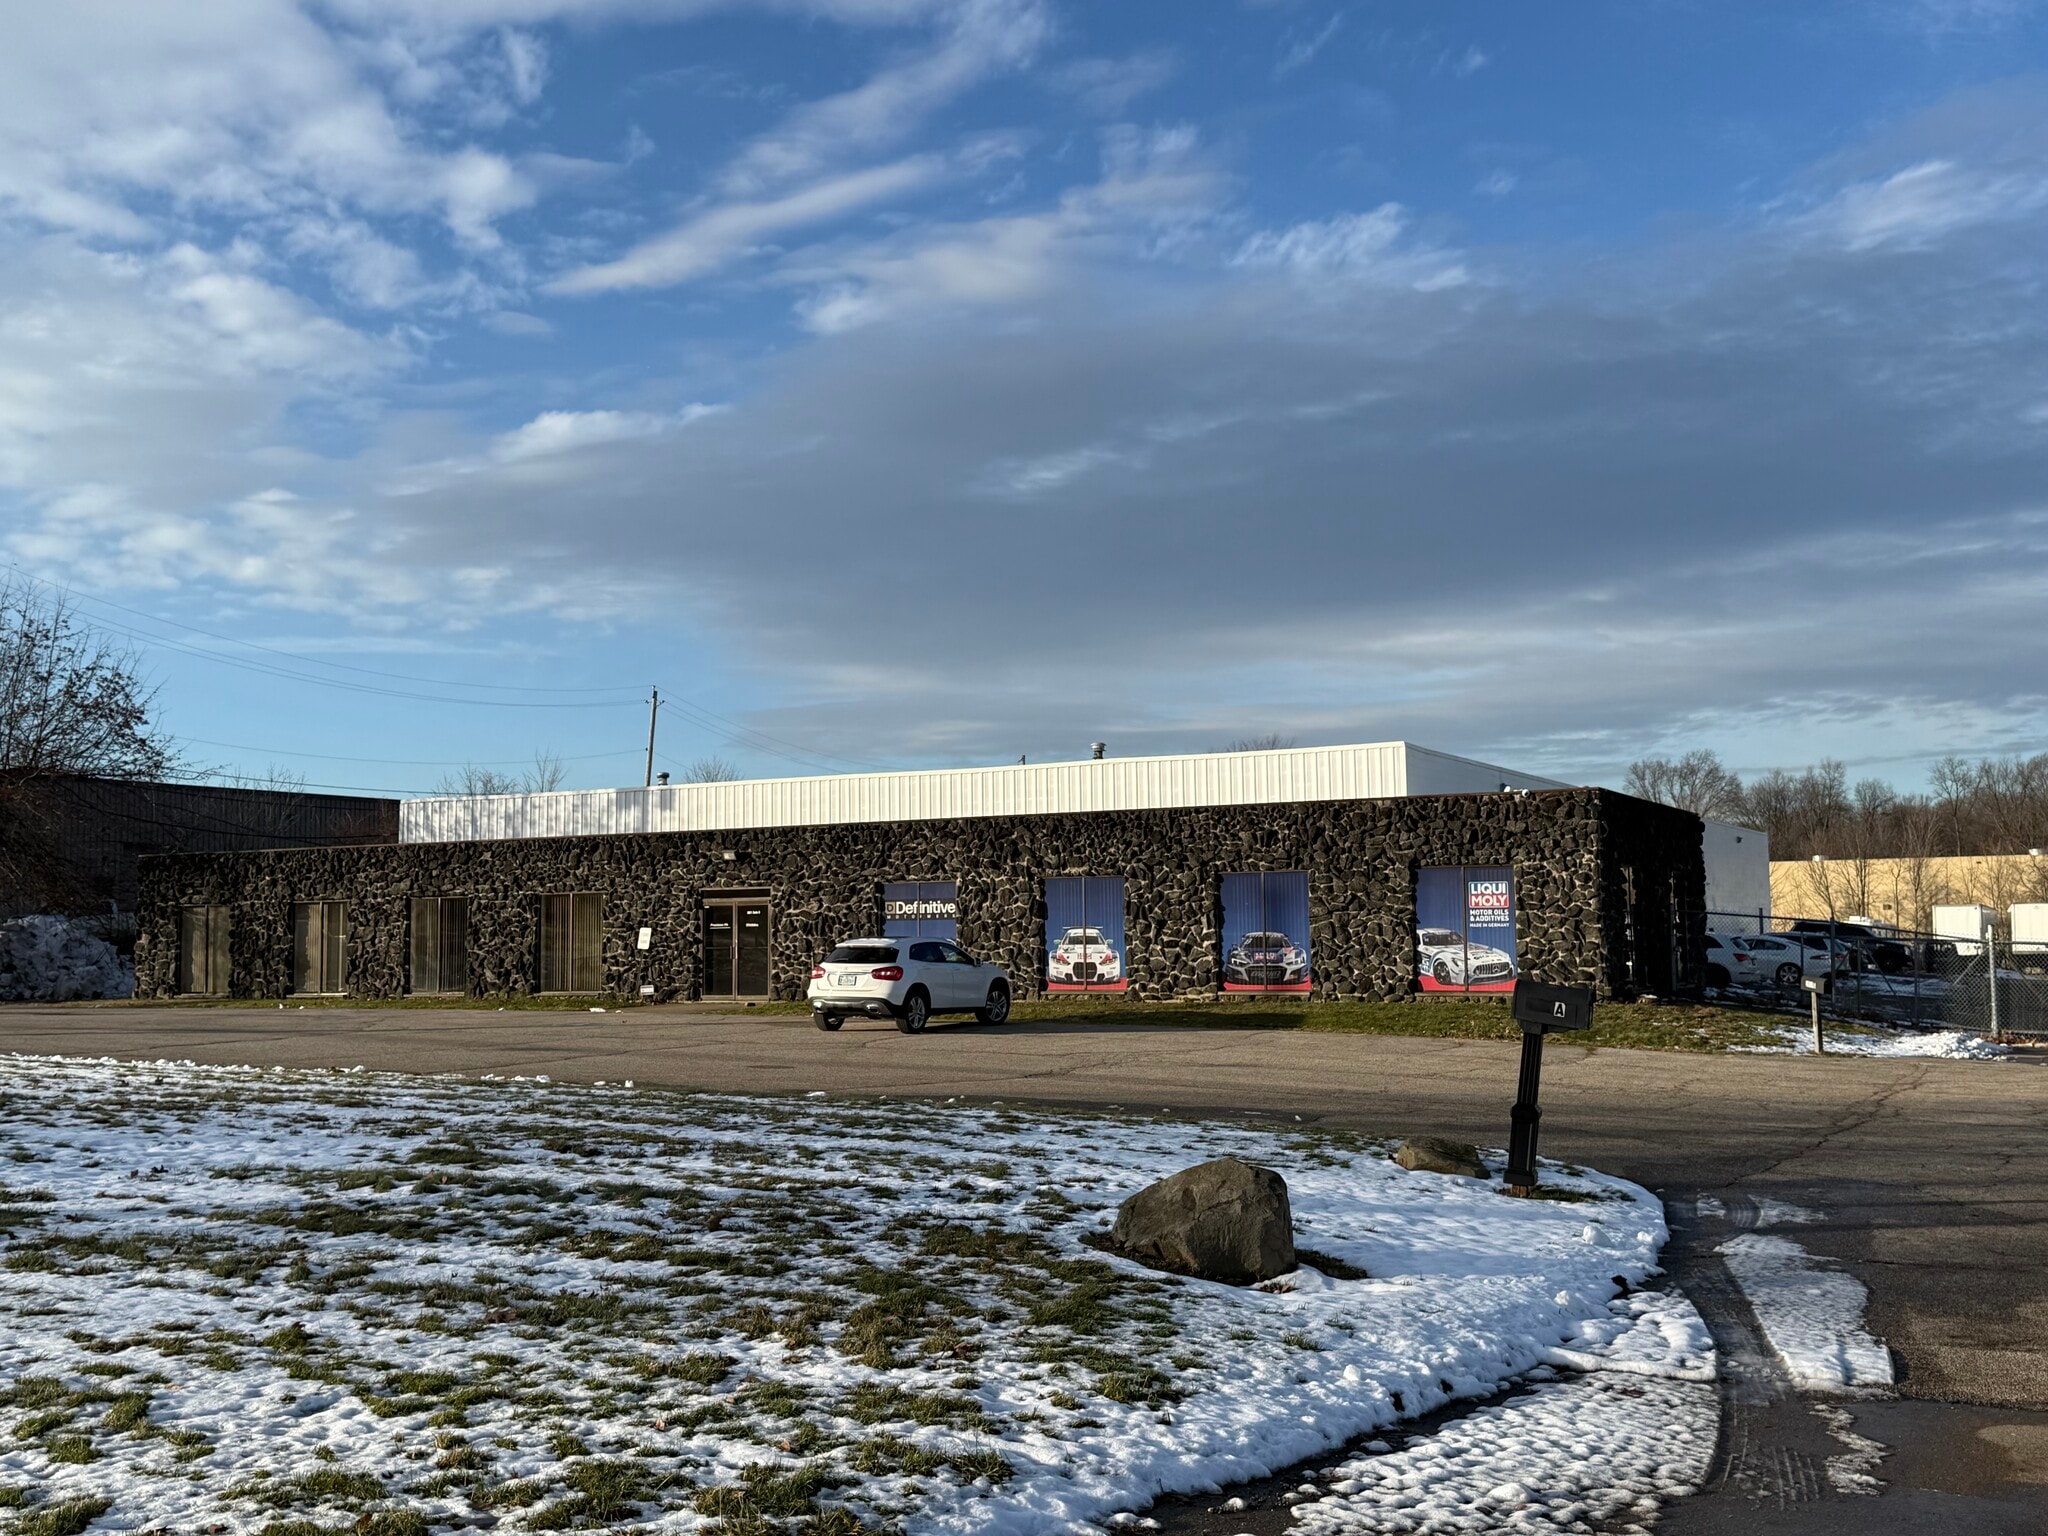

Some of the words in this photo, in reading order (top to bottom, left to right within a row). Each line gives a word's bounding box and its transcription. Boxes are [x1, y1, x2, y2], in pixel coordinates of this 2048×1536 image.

[1471, 883, 1506, 894] LIQUI
[1471, 895, 1507, 906] MOLY
[896, 900, 955, 914] Definitive
[1555, 1003, 1564, 1016] A
